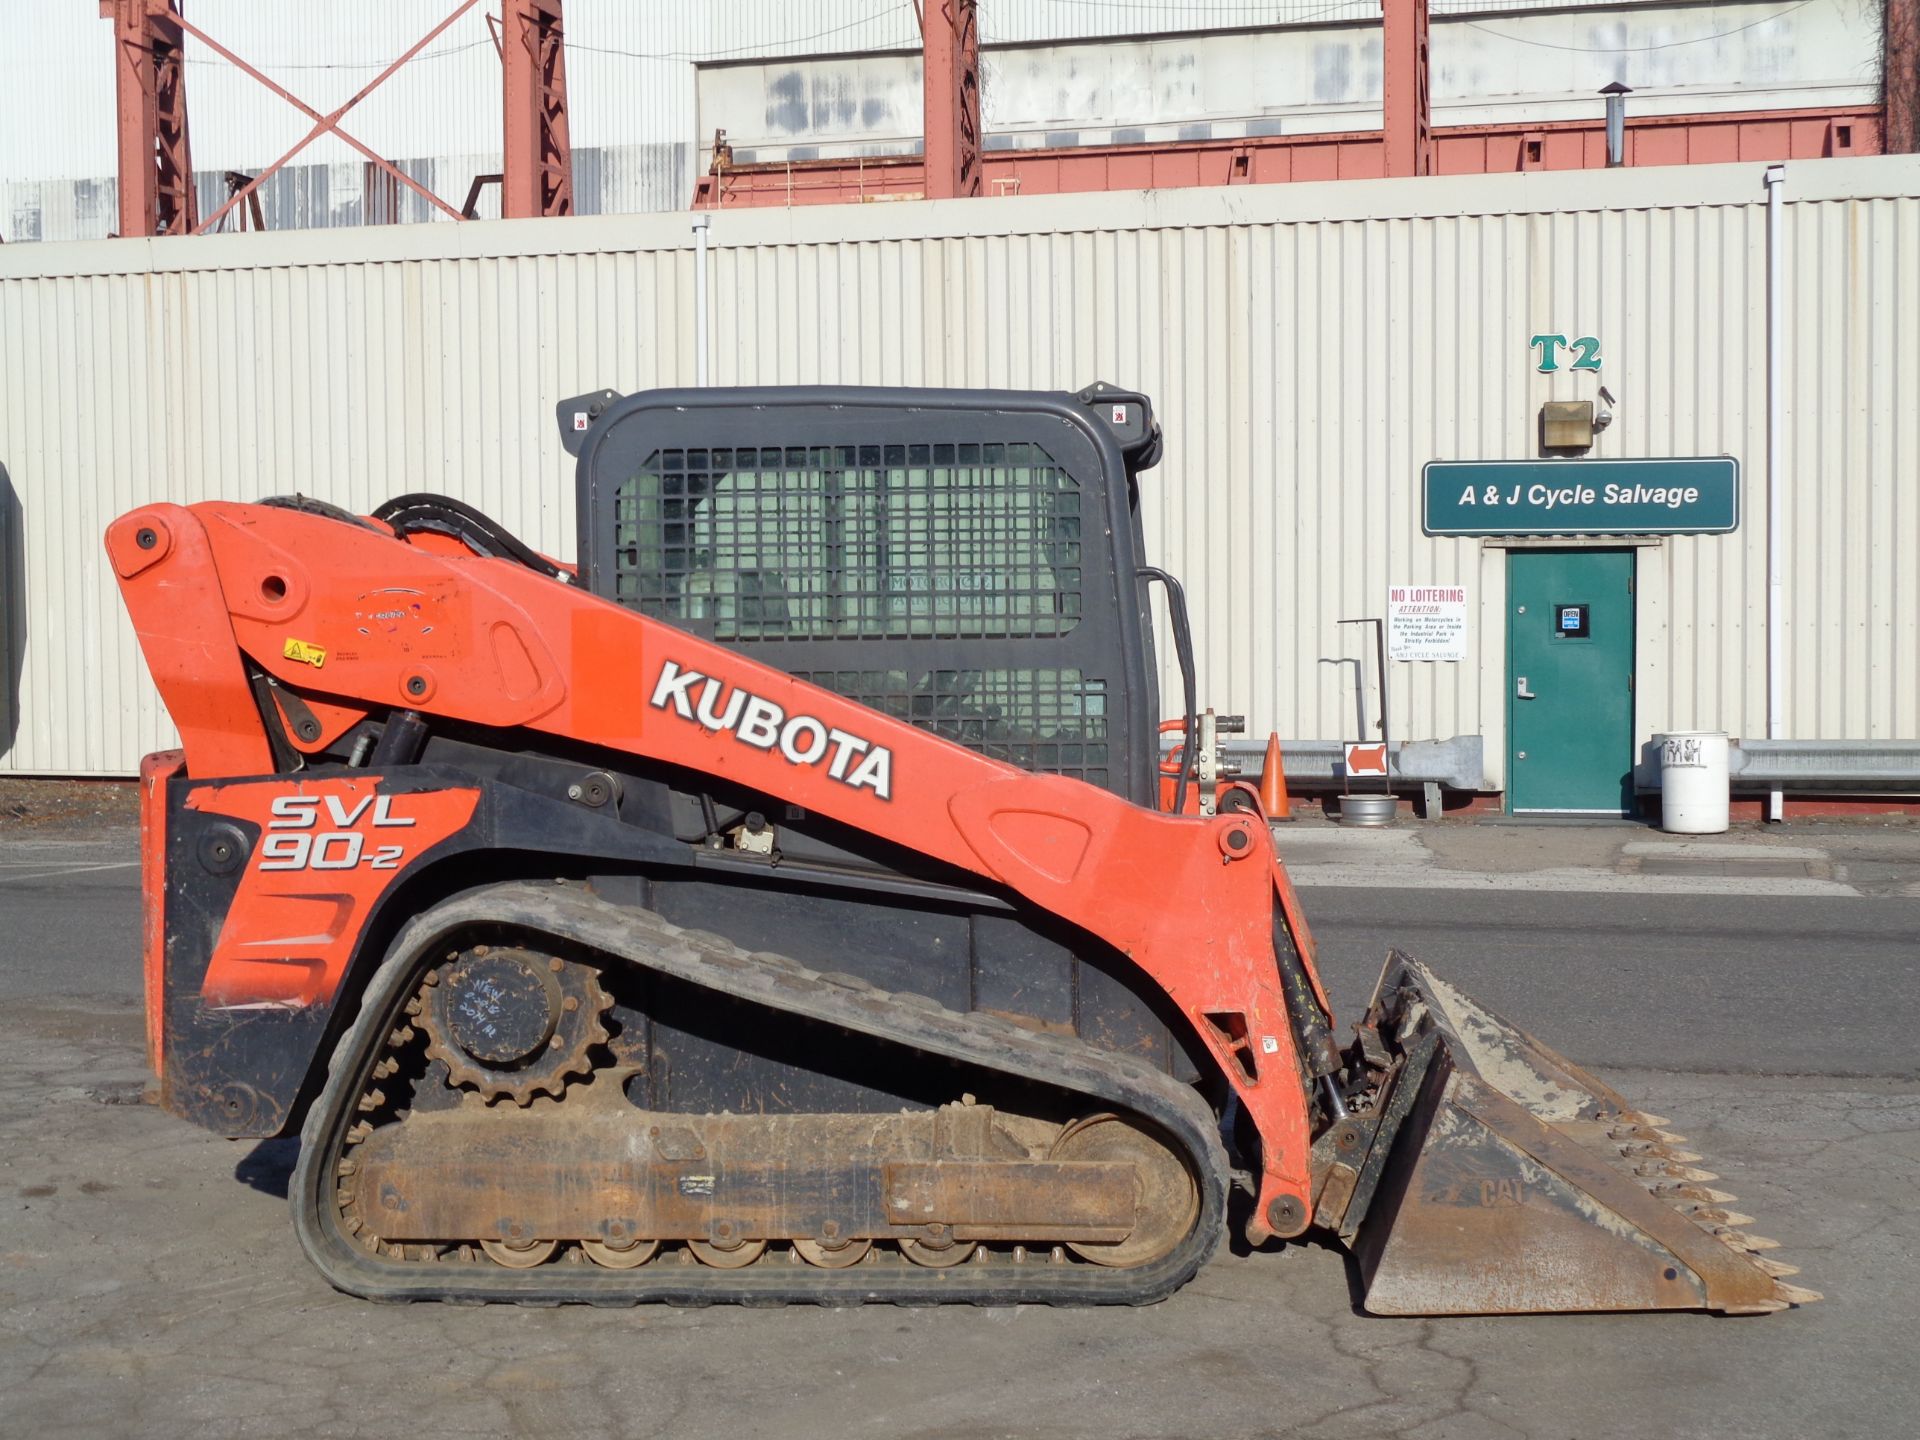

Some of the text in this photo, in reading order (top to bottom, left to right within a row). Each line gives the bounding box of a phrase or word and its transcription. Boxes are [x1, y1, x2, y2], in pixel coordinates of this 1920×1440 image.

[1530, 334, 1603, 372] T2
[1458, 483, 1699, 509] A & J Cycle Salvage
[1391, 589, 1464, 602] NO LOITERING
[650, 660, 892, 801] KUBOTA
[268, 795, 416, 828] SVL
[258, 832, 403, 870] 90-2
[1480, 1178, 1524, 1209] CAT
